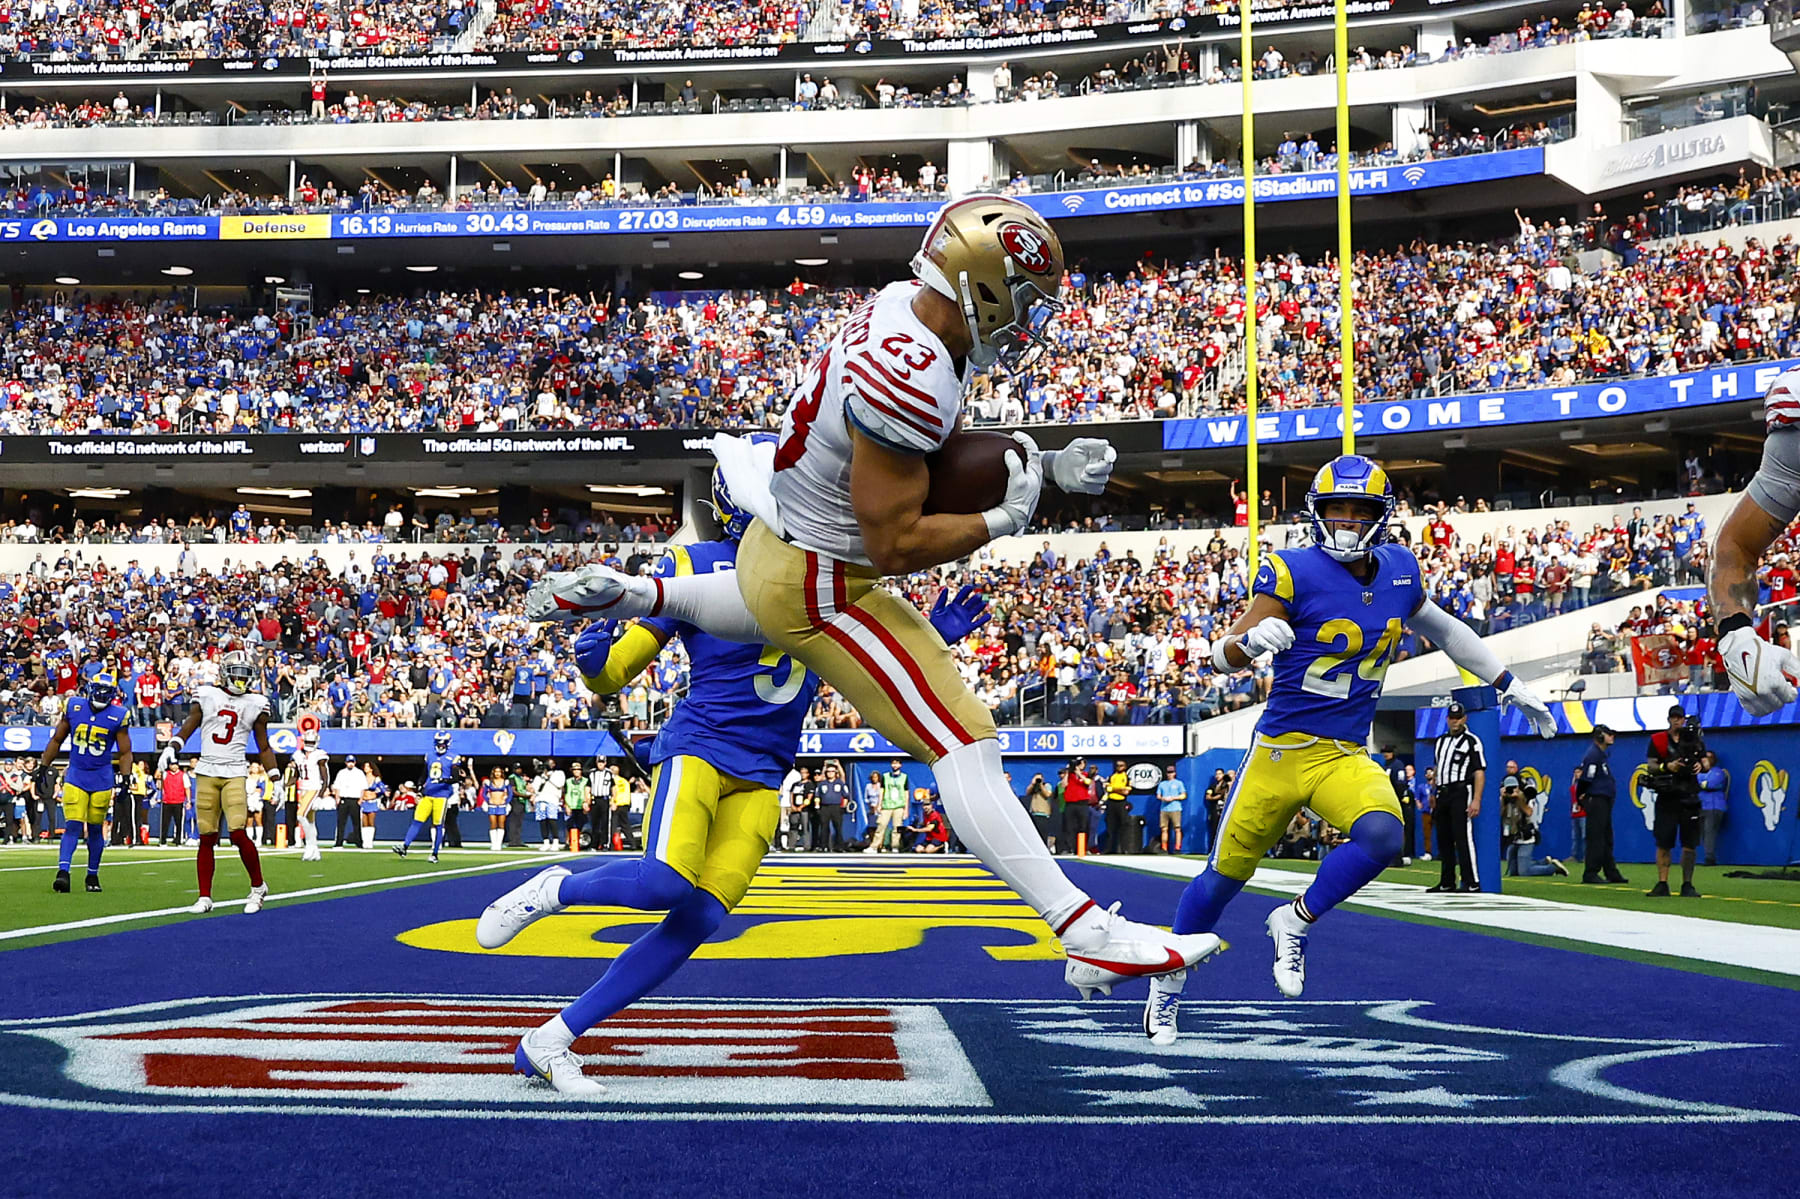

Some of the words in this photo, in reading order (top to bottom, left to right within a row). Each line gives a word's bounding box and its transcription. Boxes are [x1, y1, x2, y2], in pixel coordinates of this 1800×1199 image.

[1217, 14, 1240, 26] The
[1250, 9, 1289, 23] etwork
[1290, 7, 1336, 20] America
[1346, 2, 1373, 14] elies
[1374, 1, 1390, 12] on
[1128, 22, 1160, 34] verizon
[903, 40, 924, 53] The
[926, 38, 964, 52] official
[966, 38, 983, 50] 5G
[984, 35, 1029, 49] network
[1031, 33, 1042, 46] of
[1043, 31, 1061, 44] the
[1062, 29, 1098, 42] Rams.
[614, 49, 636, 61] The
[637, 48, 682, 61] network
[684, 47, 731, 60] America
[731, 47, 761, 58] relies
[762, 48, 778, 57] on
[814, 44, 846, 54] verizon
[309, 58, 330, 69] The
[331, 57, 366, 69] official
[368, 57, 385, 68] 5G
[385, 55, 429, 67] network
[430, 56, 441, 67] of
[443, 55, 461, 66] the
[462, 54, 497, 65] Rams.
[527, 53, 558, 62] verizon
[32, 62, 53, 73] The
[53, 61, 97, 73] network
[99, 61, 143, 73] America
[144, 61, 174, 72] relies
[175, 62, 189, 71] on
[224, 62, 254, 71] verizon
[1104, 190, 1179, 209] Connect
[1183, 187, 1203, 203] to
[243, 221, 307, 234] Defense
[340, 215, 391, 235] 16.13
[395, 222, 433, 234] Hurries
[433, 222, 458, 233] Rate
[466, 213, 529, 232] 30.43
[532, 219, 585, 232] Pressures
[585, 219, 610, 231] Rate
[618, 211, 679, 230] 27.03
[682, 215, 742, 229] Disruptions
[743, 214, 768, 227] Rate
[776, 207, 825, 225] 4.59
[829, 213, 853, 227] Avg.
[855, 211, 913, 226] Separation
[914, 212, 926, 223] to
[67, 222, 95, 237] Los
[97, 221, 159, 240] Angeles
[163, 221, 207, 236] Rams
[880, 332, 938, 371] 23
[1208, 403, 1504, 443] WELCOME
[1552, 386, 1627, 415] TO
[1669, 366, 1781, 403] THE
[49, 441, 72, 454] The
[73, 441, 115, 454] official
[116, 442, 135, 454] 5G
[136, 441, 185, 454] network
[187, 441, 201, 453] of
[202, 441, 222, 453] the
[223, 441, 253, 454] NFL.
[300, 441, 345, 453] verizon
[423, 439, 448, 452] The
[449, 438, 491, 452] official
[493, 439, 512, 452] 5G
[513, 438, 565, 452] network
[567, 438, 581, 451] of
[582, 438, 602, 451] the
[604, 437, 634, 450] NFL.
[683, 436, 713, 450] veriz
[1393, 578, 1412, 587] RAMS
[1302, 617, 1403, 700] 24
[212, 709, 239, 745] 3
[73, 723, 109, 756] 45
[800, 733, 823, 753] 14
[1033, 733, 1058, 750] :40
[1072, 734, 1095, 748] 3rd
[1113, 734, 1121, 747] 3
[1133, 769, 1154, 778] FOX
